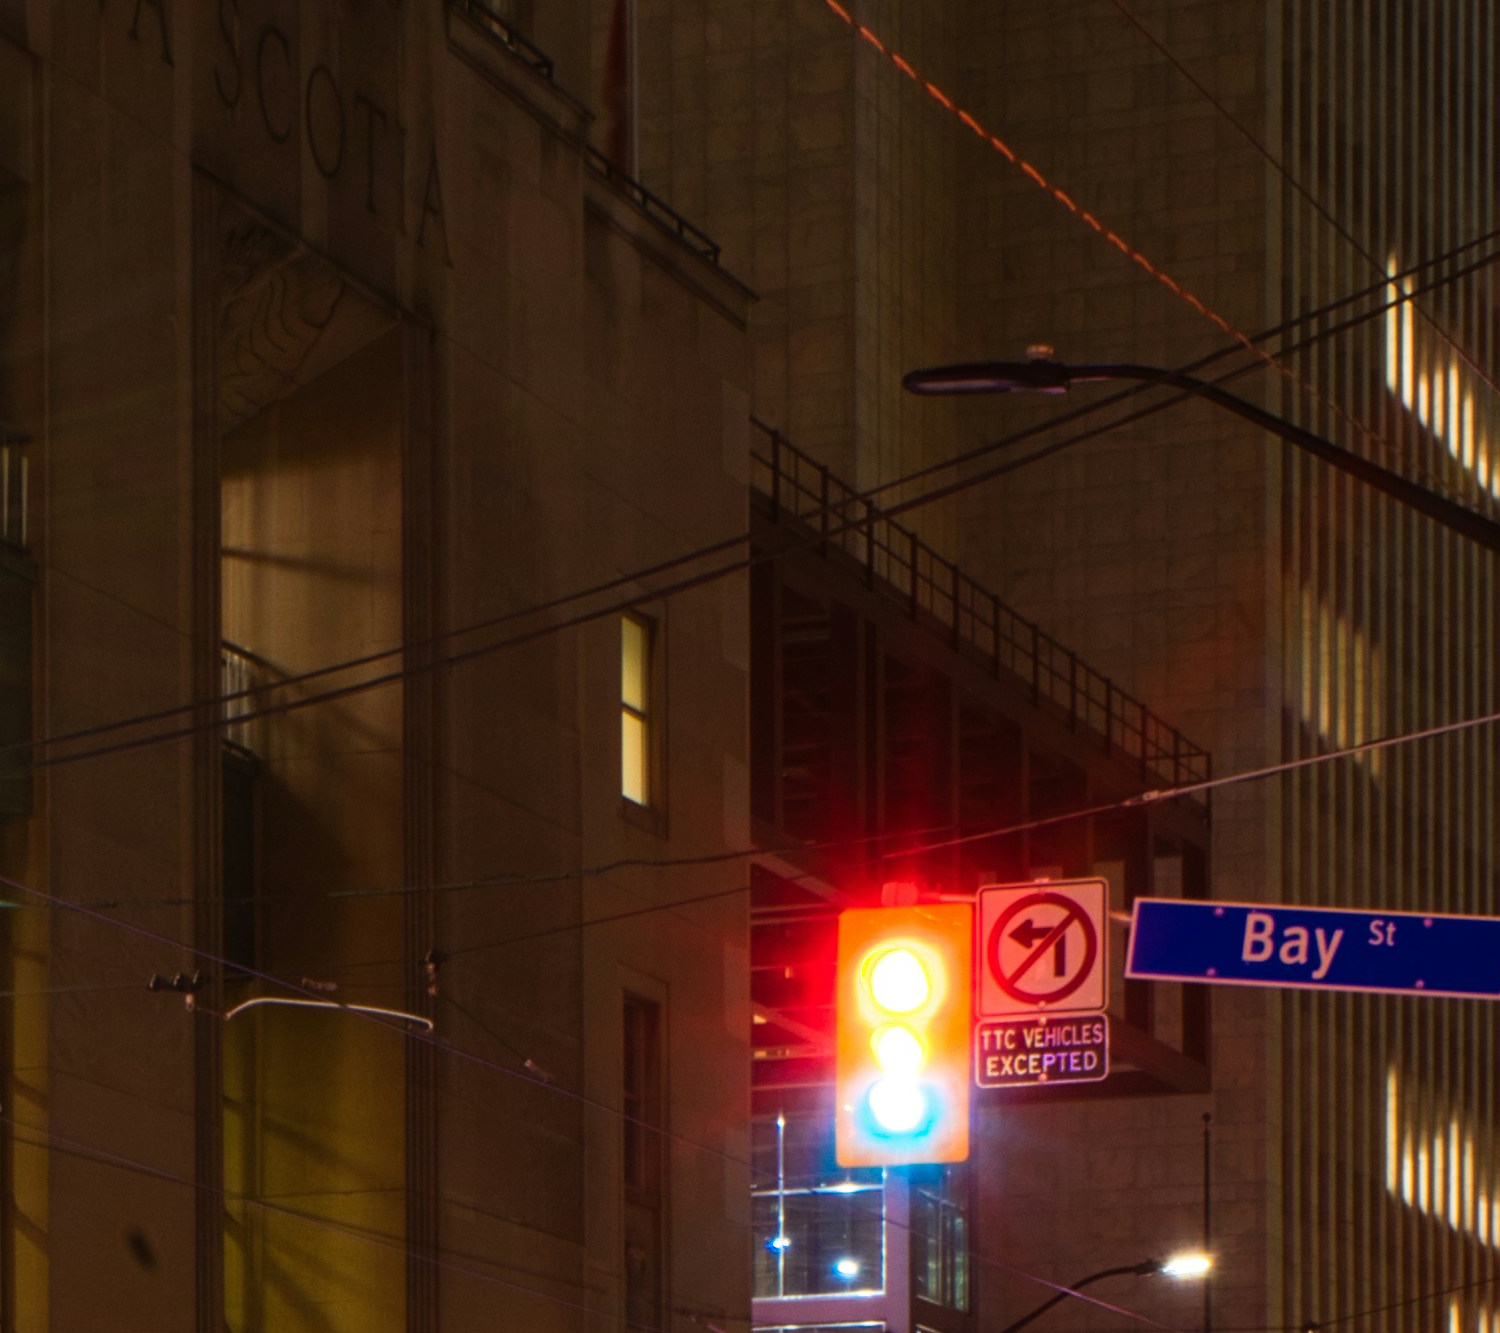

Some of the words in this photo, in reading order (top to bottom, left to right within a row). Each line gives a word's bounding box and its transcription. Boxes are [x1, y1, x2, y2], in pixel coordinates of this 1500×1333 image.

[1241, 911, 1345, 980] Bay
[1368, 919, 1397, 947] St
[981, 1029, 1016, 1051] TTC
[1022, 1023, 1104, 1049] VEHICLES
[985, 1050, 1098, 1077] EXCEPTED
